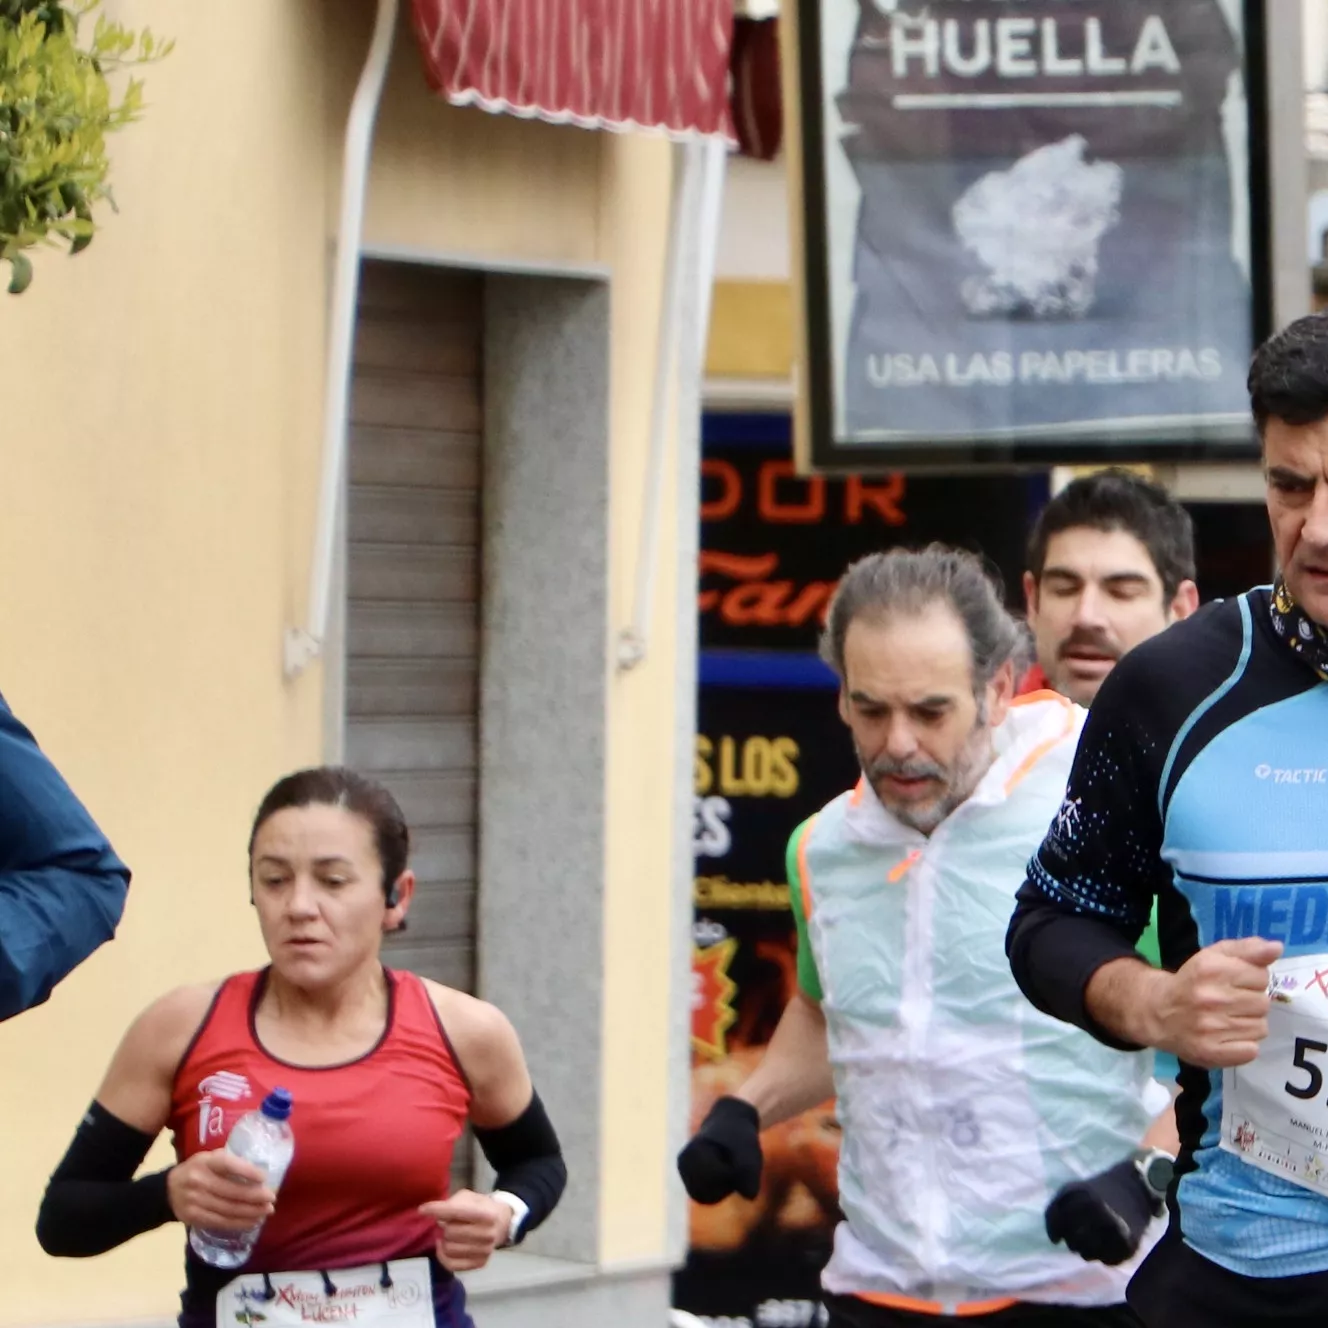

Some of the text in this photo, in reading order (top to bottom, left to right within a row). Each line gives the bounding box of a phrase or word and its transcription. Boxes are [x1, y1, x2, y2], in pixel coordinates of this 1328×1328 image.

[890, 14, 1181, 78] HUELLA
[867, 347, 1223, 388] USA LAS PAPELERAS
[719, 734, 799, 798] LOS
[1274, 768, 1328, 785] TACTIC
[1289, 1117, 1324, 1138] MANUEL
[301, 1302, 364, 1323] LUCENA
